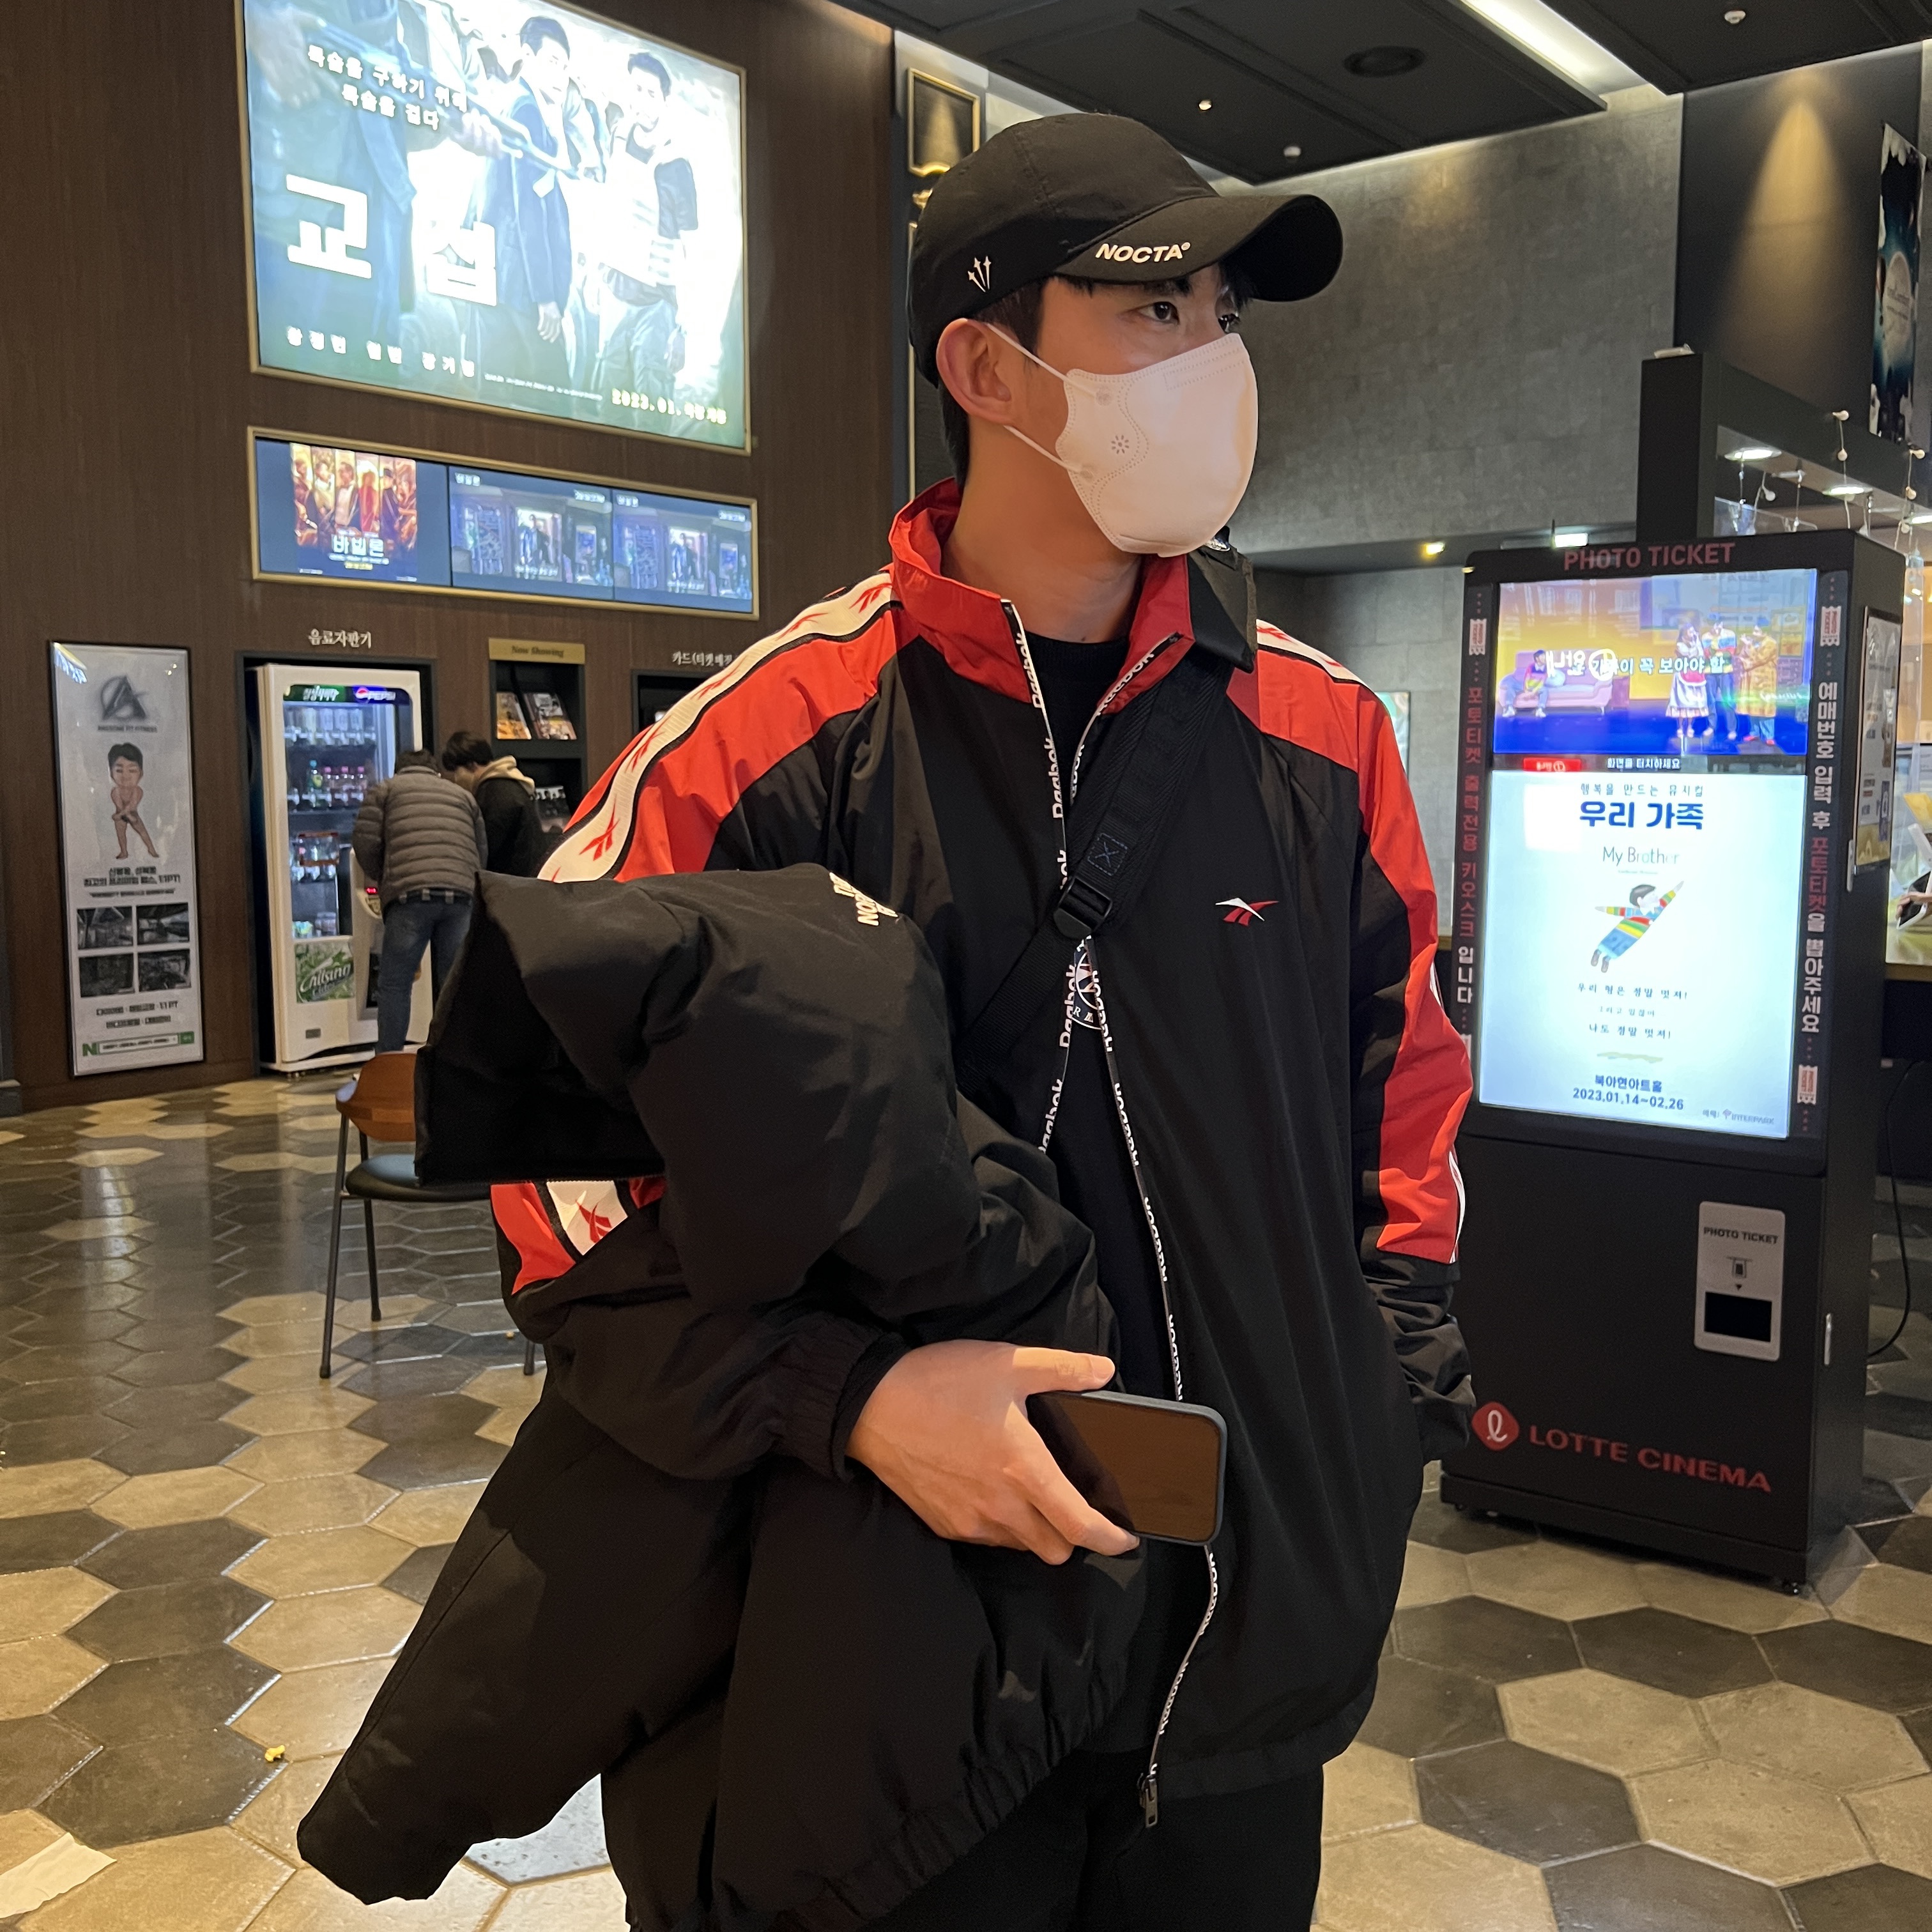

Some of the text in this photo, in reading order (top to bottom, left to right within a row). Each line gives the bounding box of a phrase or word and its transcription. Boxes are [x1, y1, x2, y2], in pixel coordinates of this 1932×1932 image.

[1096, 243, 1183, 263] NOCTA
[1565, 542, 1735, 571] PHOTO TICKET
[308, 628, 371, 648] 음료자판기
[1659, 657, 1705, 674] 보아야
[1815, 681, 1837, 760] 예매번호
[1636, 758, 1681, 770] 터치하세요
[1623, 783, 1659, 797] 만드는
[1813, 766, 1832, 804] 입력
[1579, 801, 1704, 830] 우리 가족
[1812, 811, 1830, 830] 후
[1602, 846, 1623, 867] My
[1459, 862, 1477, 938] 키오스크
[1457, 946, 1474, 1004] 입니다
[1802, 939, 1824, 1034] 뽑아주세요
[1595, 1075, 1662, 1093] 북아현아트홀
[1573, 1087, 1684, 1110] 2023.01.14~02.26
[1704, 1227, 1778, 1245] PHOTO TICKET
[1529, 1425, 1772, 1493] LOTTE CINEMA
